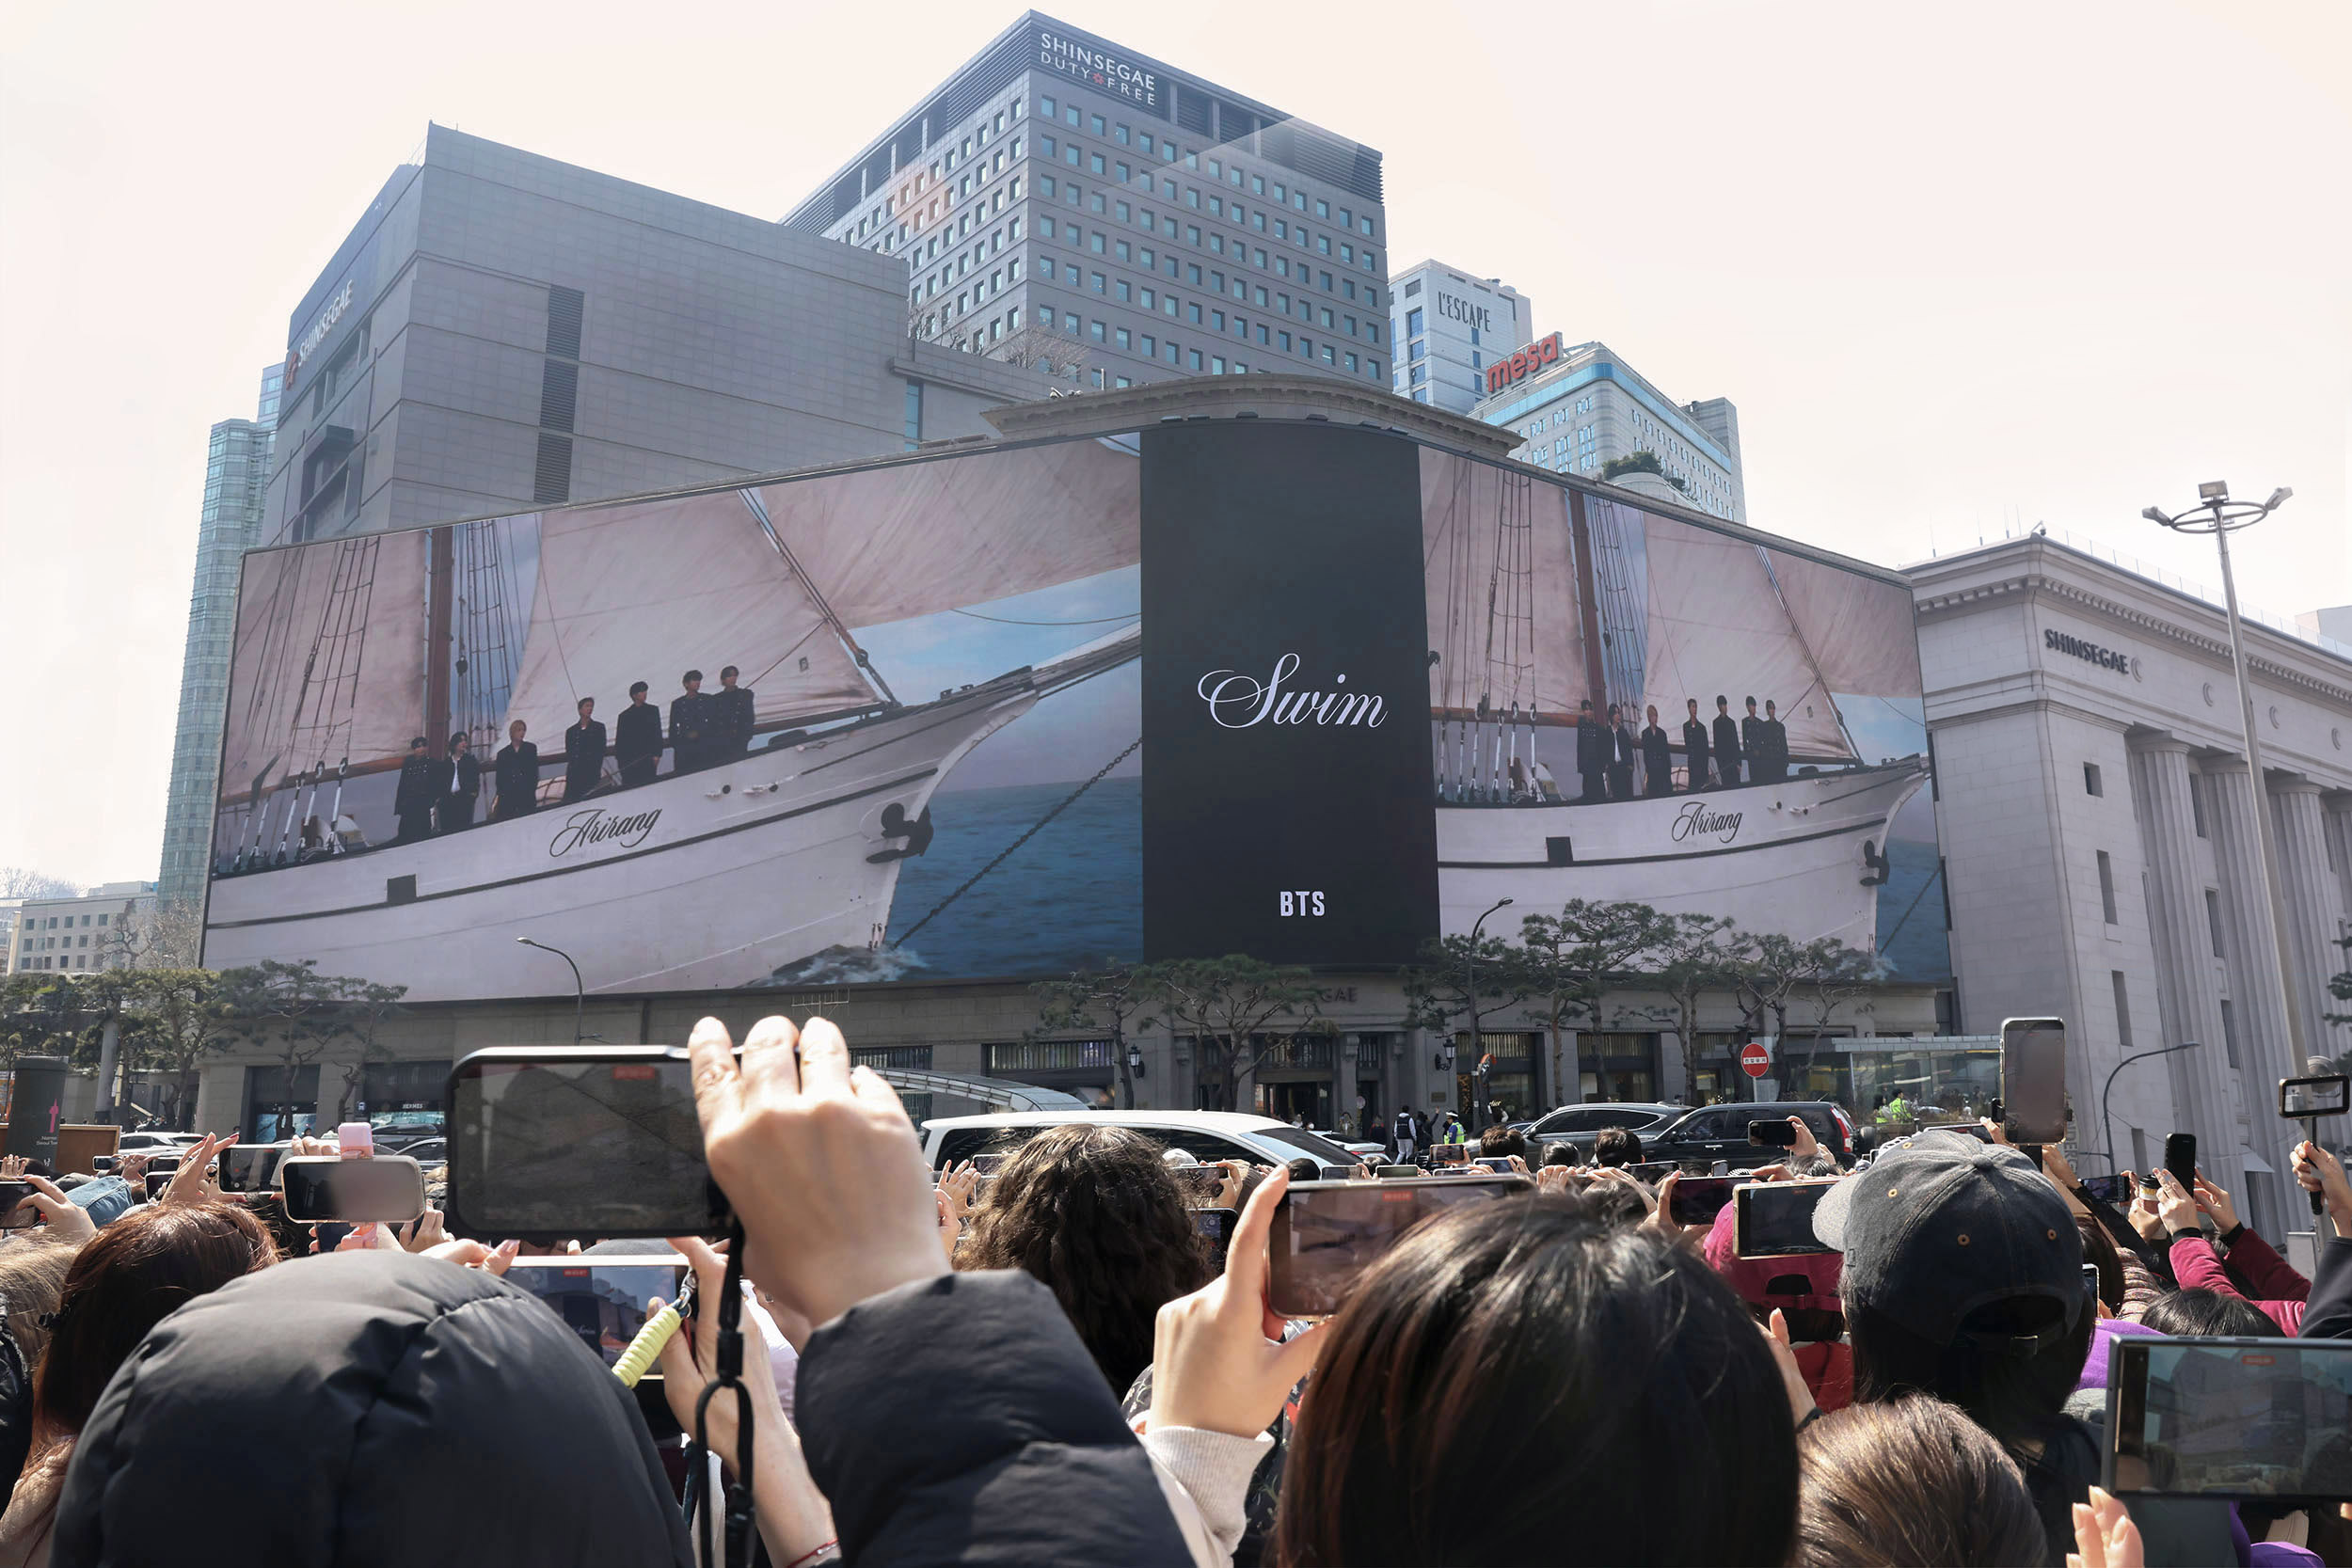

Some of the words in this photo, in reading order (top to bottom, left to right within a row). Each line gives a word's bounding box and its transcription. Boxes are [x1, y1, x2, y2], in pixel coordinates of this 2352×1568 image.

[1041, 33, 1154, 91] SHINSEGAE
[1041, 51, 1090, 79] DUTY
[1107, 77, 1155, 105] FREE
[298, 279, 352, 367] SHINSEGAE
[1438, 291, 1491, 332] L'ESCAPE
[1486, 335, 1558, 393] mesa
[2044, 628, 2129, 674] SHINSEGAE
[1198, 653, 1389, 729] Swim
[549, 808, 663, 858] Arirang
[1671, 801, 1743, 844] Arirang
[1279, 891, 1326, 917] BTS
